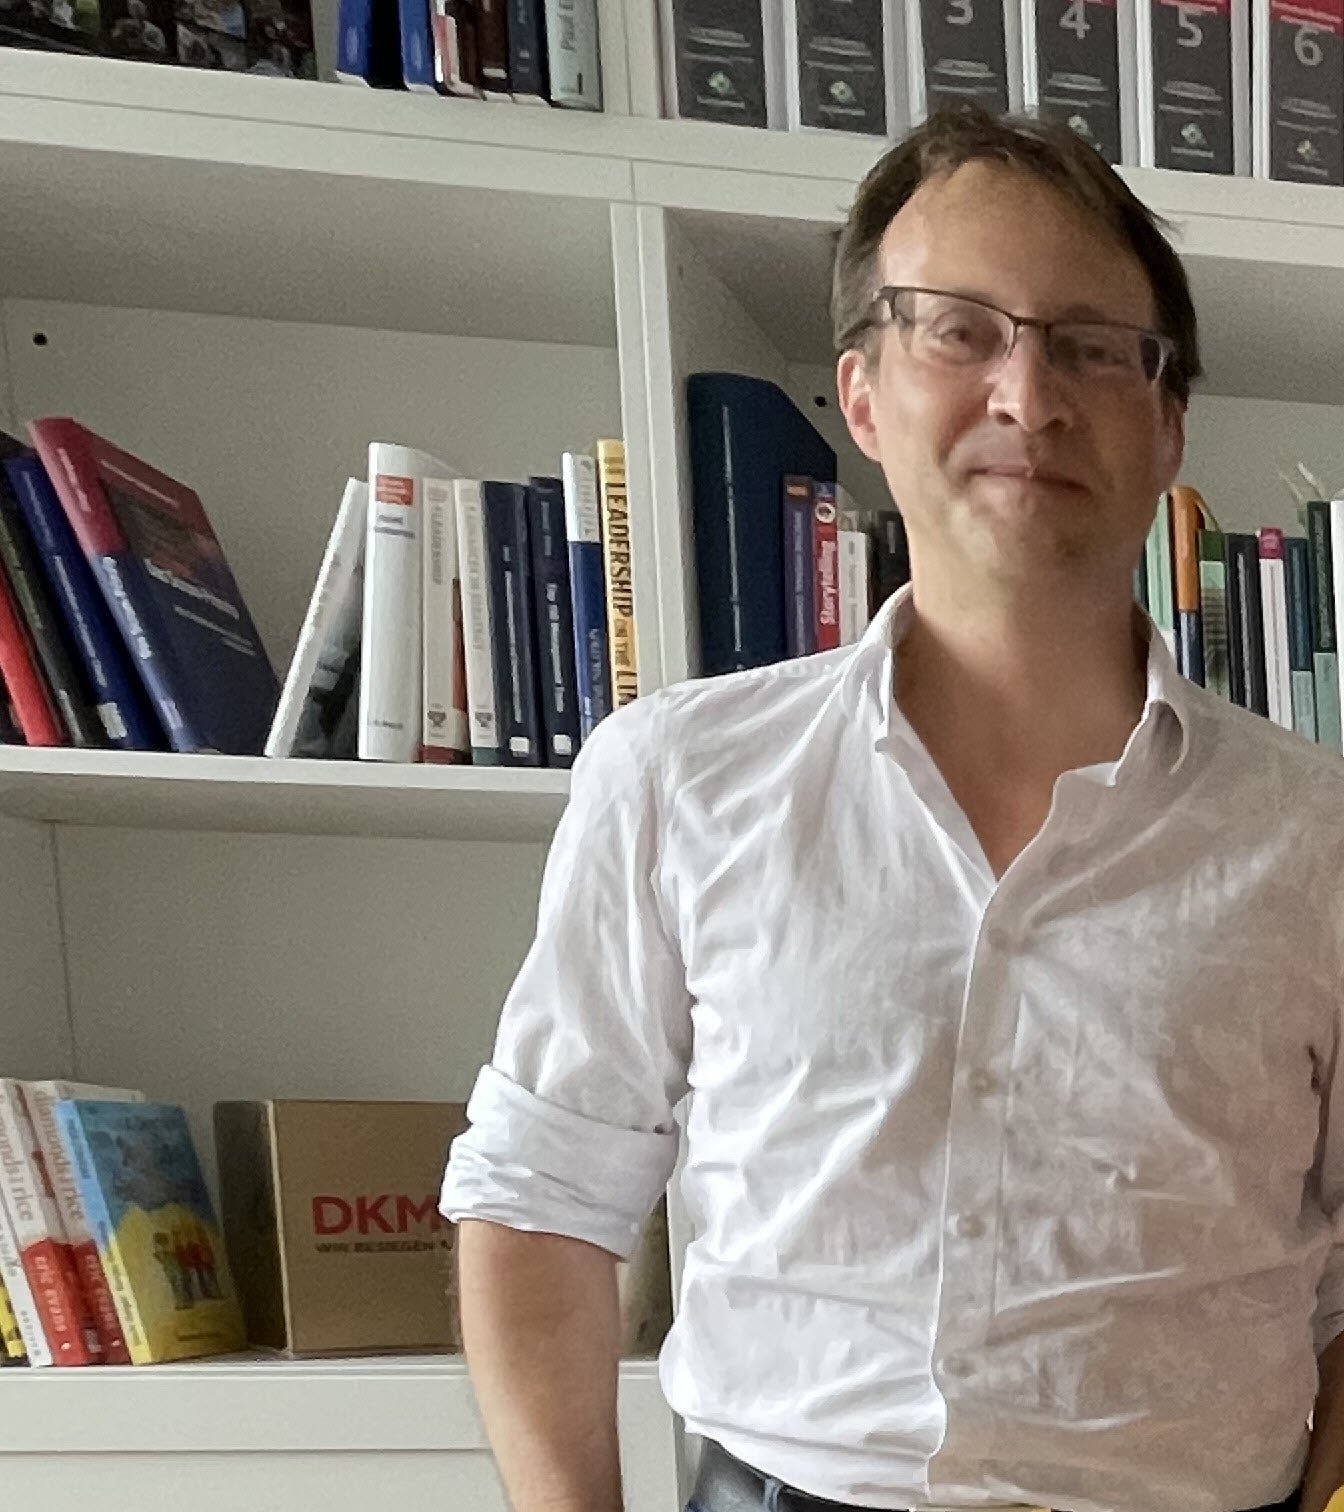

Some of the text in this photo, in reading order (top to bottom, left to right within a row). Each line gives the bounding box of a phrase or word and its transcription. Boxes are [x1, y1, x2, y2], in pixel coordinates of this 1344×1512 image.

[1058, 0, 1092, 40] 4
[1176, 10, 1204, 47] 5
[1294, 27, 1324, 67] 6
[604, 482, 635, 617] LEADERSHIP
[819, 541, 838, 625] Storytelling
[616, 671, 638, 707] LIN
[312, 1194, 443, 1236] DKM
